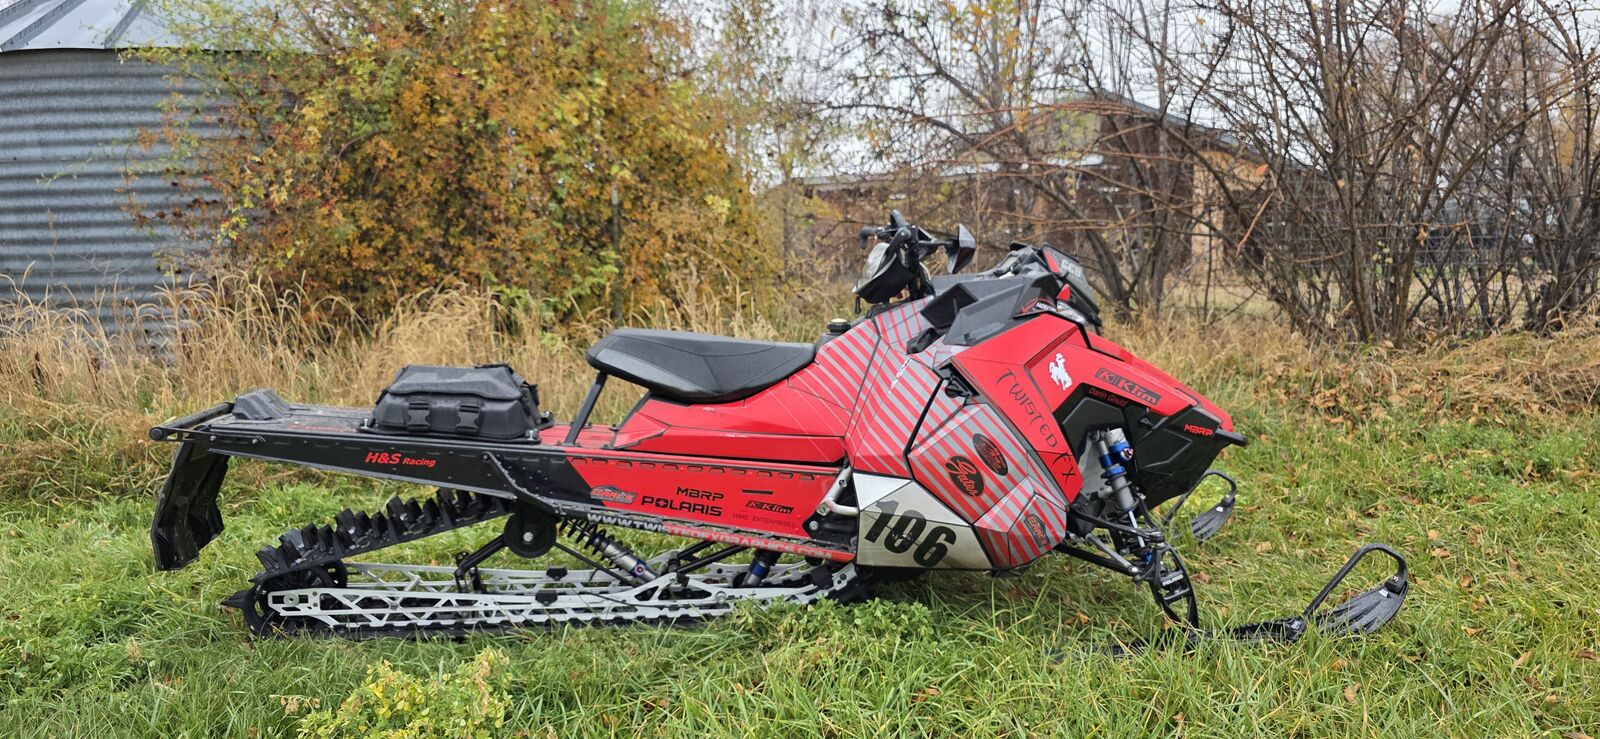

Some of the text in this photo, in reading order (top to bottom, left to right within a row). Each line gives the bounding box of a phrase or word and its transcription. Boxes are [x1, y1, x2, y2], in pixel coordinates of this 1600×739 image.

[1118, 381, 1158, 405] Klim
[996, 369, 1076, 484] TWISTED FX
[1183, 424, 1214, 437] MBRP
[365, 452, 437, 468] H&S Racing
[944, 459, 979, 498] Gates
[676, 487, 724, 502] MBRP
[641, 496, 722, 517] POLARIS
[761, 503, 792, 515] Klim
[752, 516, 797, 528] ENTERPRISES
[864, 500, 957, 568] 106
